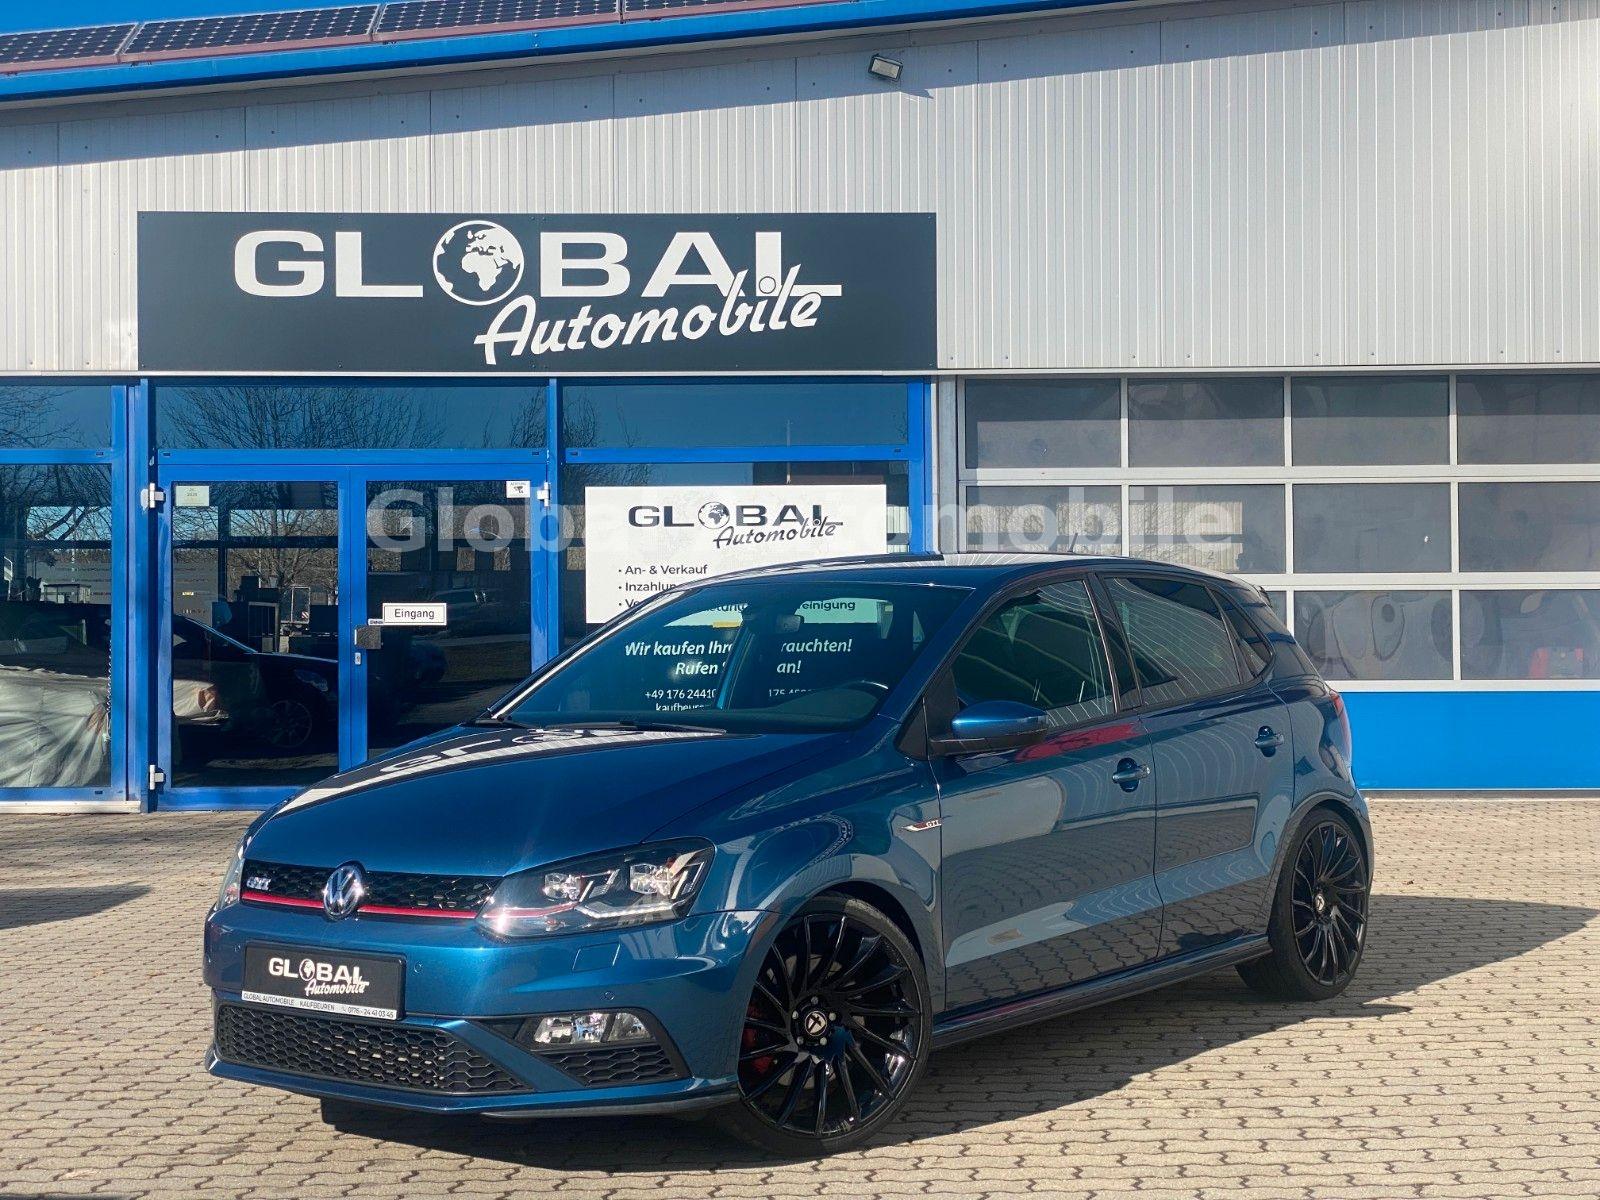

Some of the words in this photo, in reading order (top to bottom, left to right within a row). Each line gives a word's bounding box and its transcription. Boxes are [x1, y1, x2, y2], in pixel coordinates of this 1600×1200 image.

[233, 219, 843, 307] GLOBAL
[473, 262, 823, 366] Automobile
[628, 501, 843, 529] GLOBAL
[712, 516, 837, 549] Automobile
[624, 565, 646, 575] An-
[649, 565, 658, 575] &
[660, 564, 708, 575] Verkauf
[625, 582, 678, 592] Inzahlun
[394, 608, 435, 620] Eingang
[802, 600, 856, 611] einigung
[624, 641, 651, 656] Wir
[653, 640, 705, 656] kaufen
[780, 638, 853, 653] rauchten!
[675, 662, 718, 676] Rufen
[776, 659, 802, 674] an!
[645, 689, 664, 699] +49
[666, 689, 685, 699] 176
[304, 975, 367, 997] Automobile
